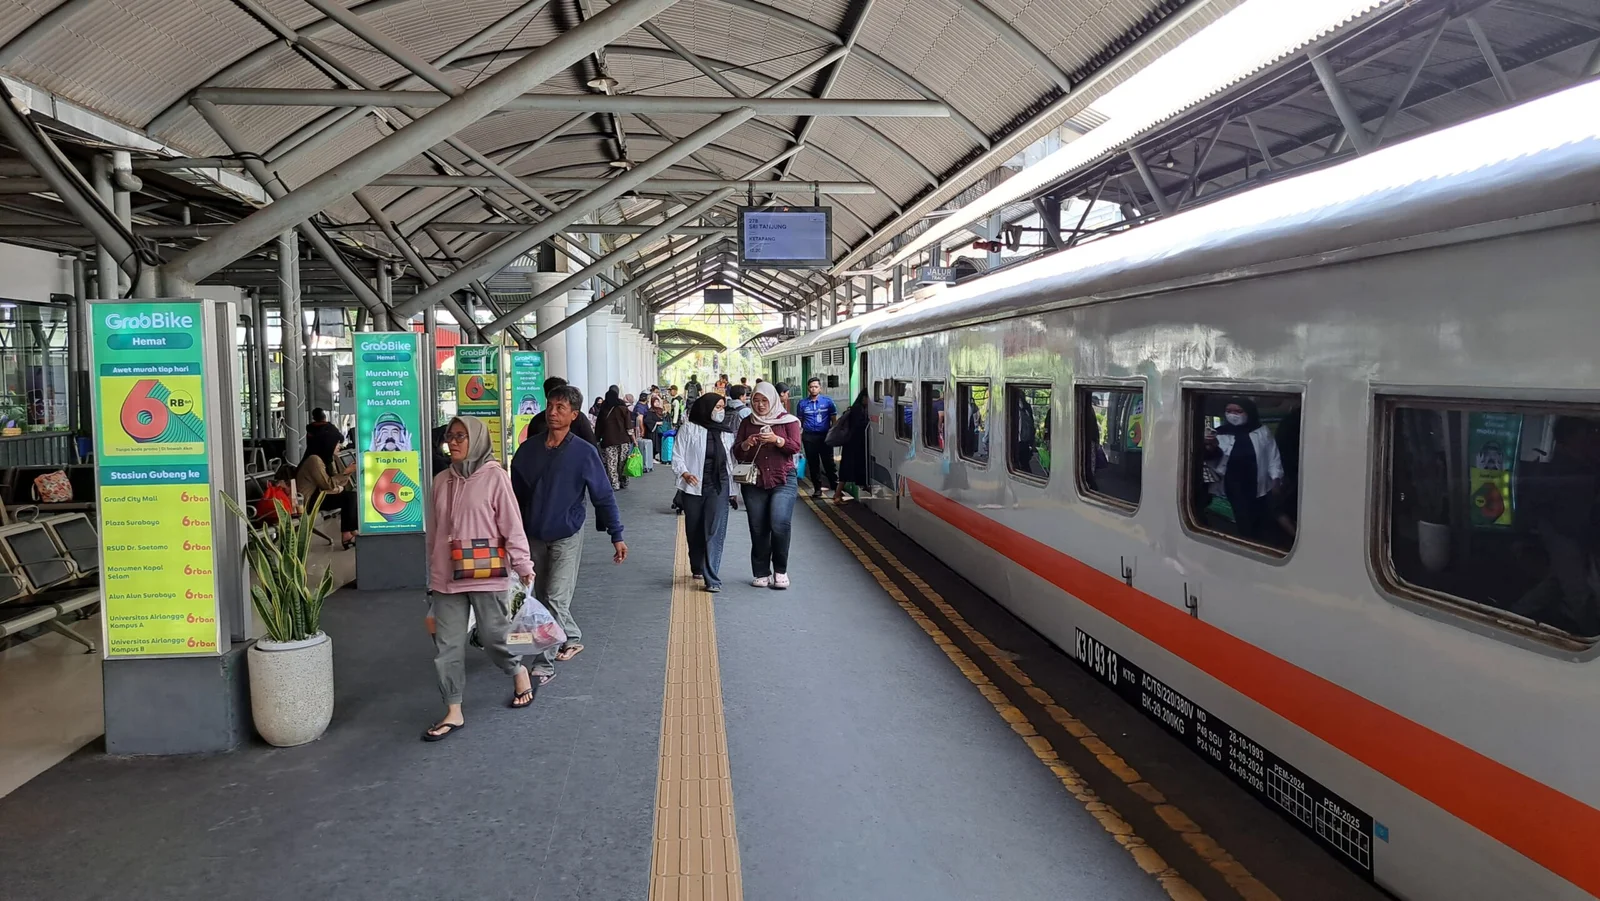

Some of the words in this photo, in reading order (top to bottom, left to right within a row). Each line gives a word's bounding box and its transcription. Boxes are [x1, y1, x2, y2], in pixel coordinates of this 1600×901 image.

[105, 312, 193, 328] GrabBike
[132, 337, 166, 346] Hemat
[361, 341, 411, 351] GrabBike
[366, 370, 409, 378] Murahnya
[120, 379, 169, 440] 6
[111, 471, 147, 480] Stasiun
[149, 471, 187, 480] Gubeng
[188, 470, 200, 478] ke
[180, 491, 209, 502] 6rban
[372, 468, 407, 515] 6
[182, 516, 210, 526] 6rban
[183, 540, 211, 551] 6rban
[184, 564, 212, 575] 6rban
[185, 588, 213, 600] 6rban
[187, 613, 214, 624] 6rban
[151, 637, 185, 645] Airlangga
[187, 637, 216, 648] 6rban
[1076, 629, 1086, 663] K3
[1088, 638, 1093, 668] 0
[1095, 643, 1105, 676] 93
[1107, 651, 1118, 685] 13
[1123, 668, 1136, 684] KTG
[1142, 674, 1193, 720] AC/TS/220/380V
[1142, 692, 1185, 735] BK-29.200KG
[1196, 709, 1206, 722] MD
[1229, 730, 1264, 761] 28-10-1993
[1196, 722, 1207, 738] P48
[1208, 731, 1222, 748] SGU
[1229, 744, 1264, 777] 24-09-2024
[1196, 737, 1207, 752] P24
[1208, 743, 1222, 761] YAD
[1229, 759, 1264, 792] 24-09-2026
[1274, 764, 1305, 790] PEM-2024
[1324, 798, 1360, 828] PEM-2025
